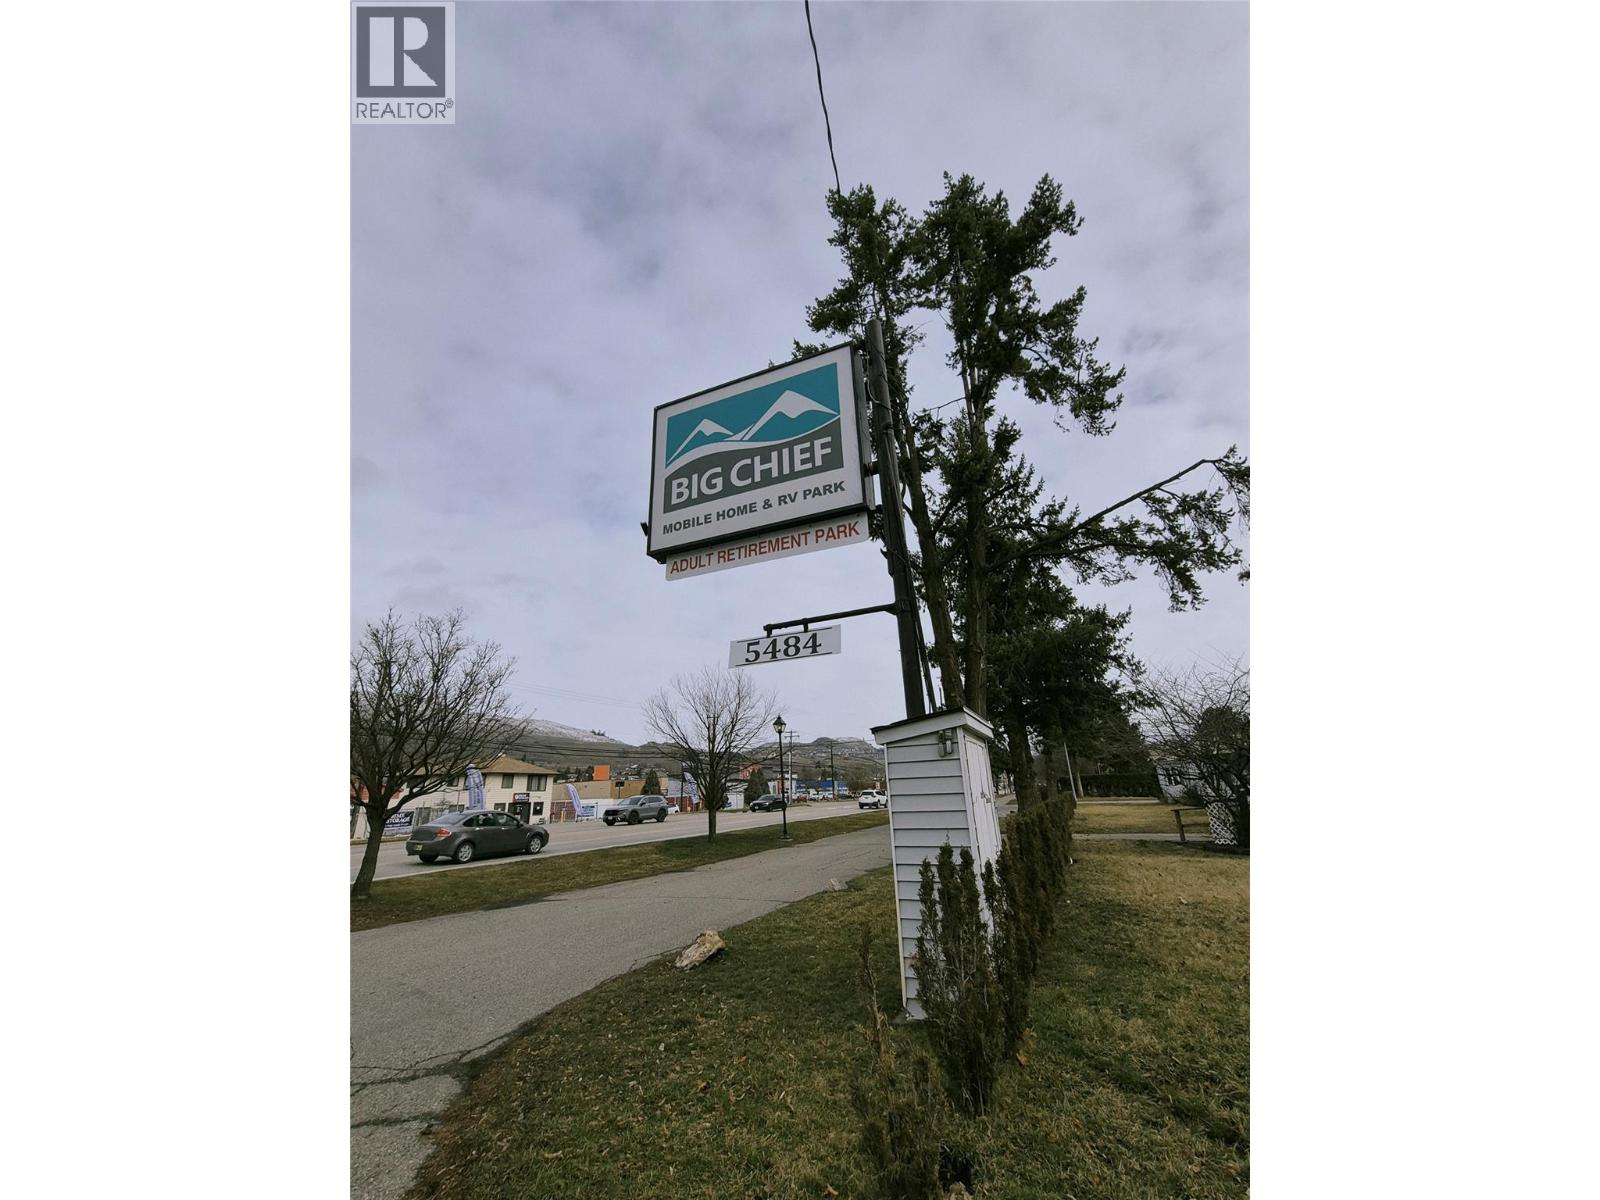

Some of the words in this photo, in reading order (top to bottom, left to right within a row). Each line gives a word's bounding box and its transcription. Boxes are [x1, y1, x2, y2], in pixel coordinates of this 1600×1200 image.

[671, 466, 723, 505] BIG
[730, 436, 832, 487] CHIEF
[662, 513, 712, 535] MOBILE
[716, 502, 758, 521] HOME
[762, 499, 773, 510] &
[778, 492, 798, 507] RV
[803, 480, 846, 500] PARK
[670, 552, 714, 575] ADULT
[717, 531, 811, 565] RETIREMENT
[815, 521, 860, 544] PARK
[744, 632, 822, 662] 5484
